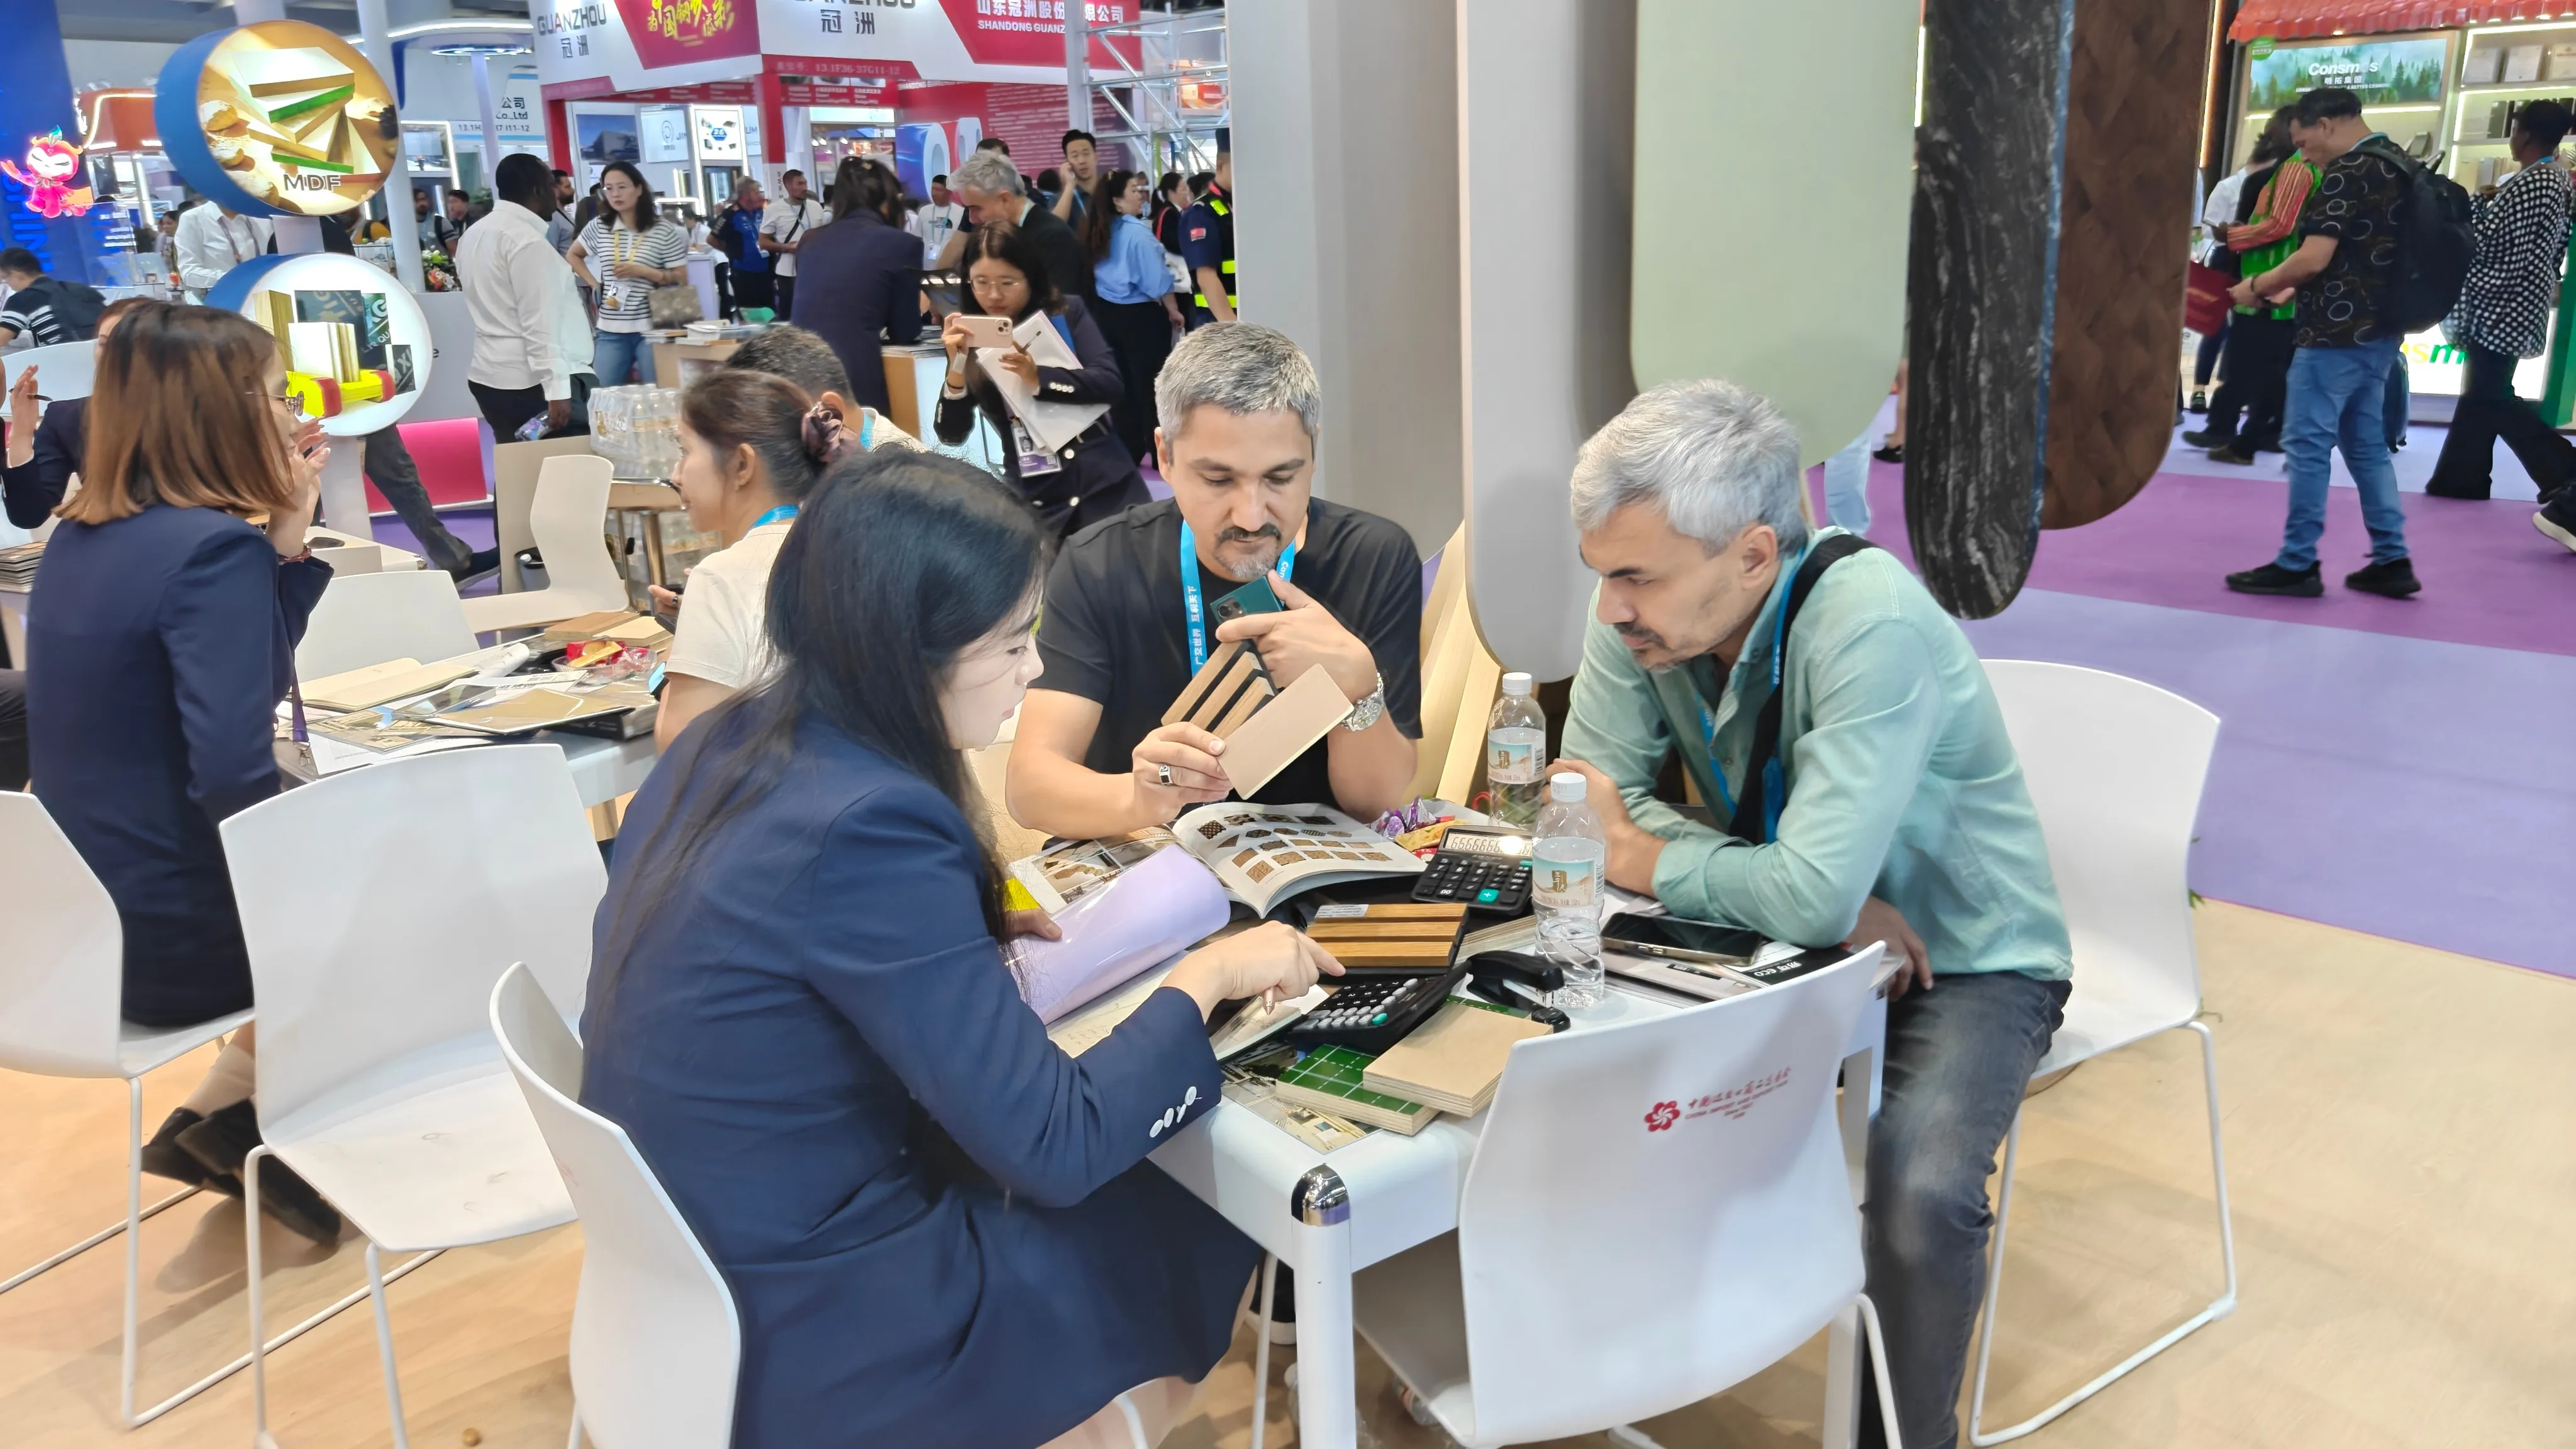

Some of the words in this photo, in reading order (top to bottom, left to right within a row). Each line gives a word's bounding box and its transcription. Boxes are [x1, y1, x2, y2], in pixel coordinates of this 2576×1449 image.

[538, 4, 607, 36] GUANZHOU
[977, 0, 1124, 23] 山东冠洲股份限公司
[820, 9, 875, 34] 冠洲
[978, 20, 1033, 31] SHANDONG
[1033, 24, 1065, 33] GUANZ
[2308, 63, 2379, 76] Consms
[501, 96, 526, 109] 公司
[283, 174, 341, 191] MDF
[1279, 562, 1289, 579] Can
